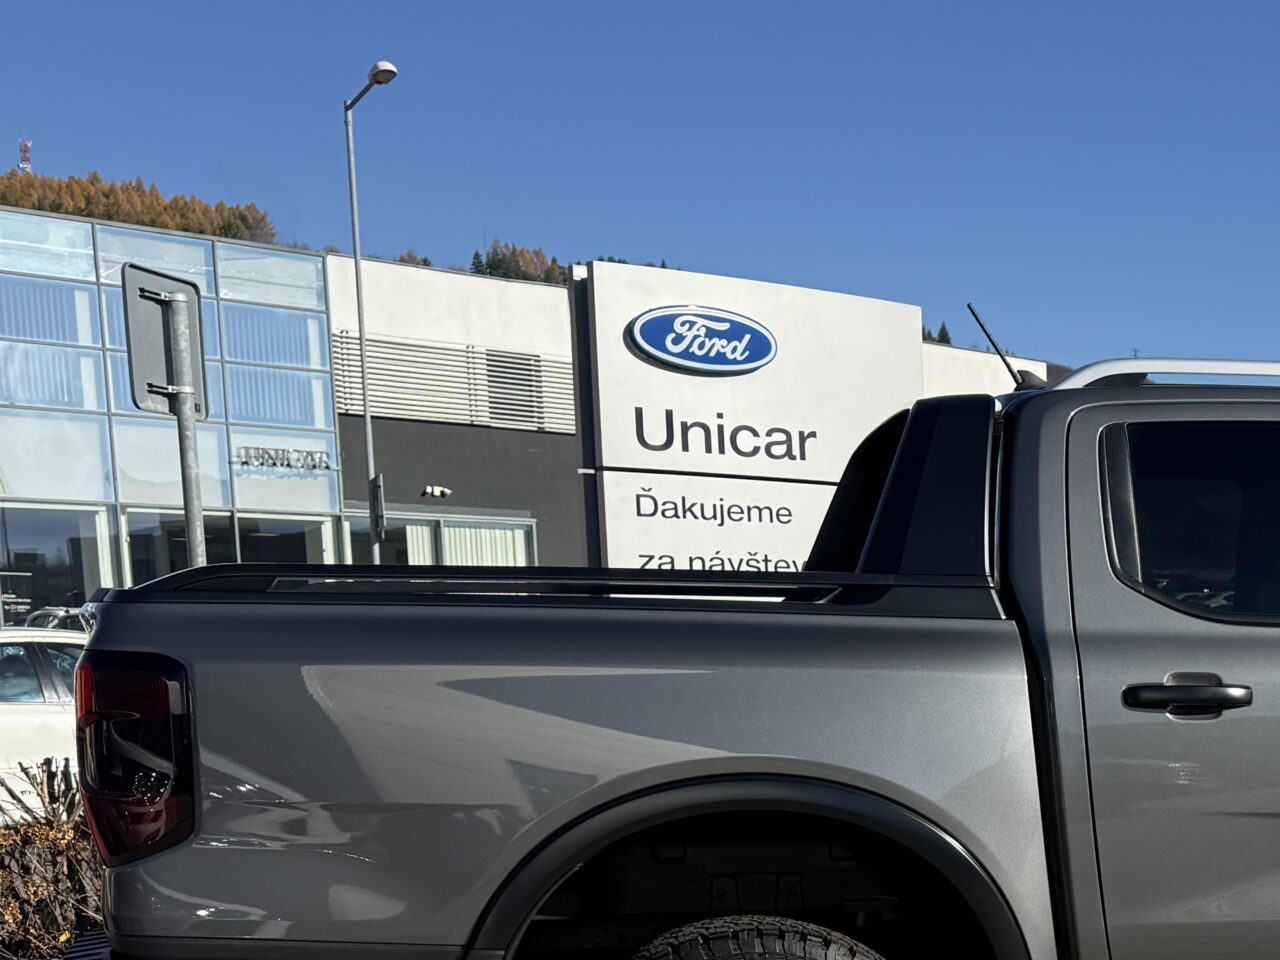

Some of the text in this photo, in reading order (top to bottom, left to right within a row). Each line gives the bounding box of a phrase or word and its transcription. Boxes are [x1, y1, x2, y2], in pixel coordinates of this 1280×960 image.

[665, 315, 751, 361] Ford
[634, 406, 818, 461] Unicar
[635, 487, 793, 527] Ďakujeme
[638, 551, 807, 572] za návštev
